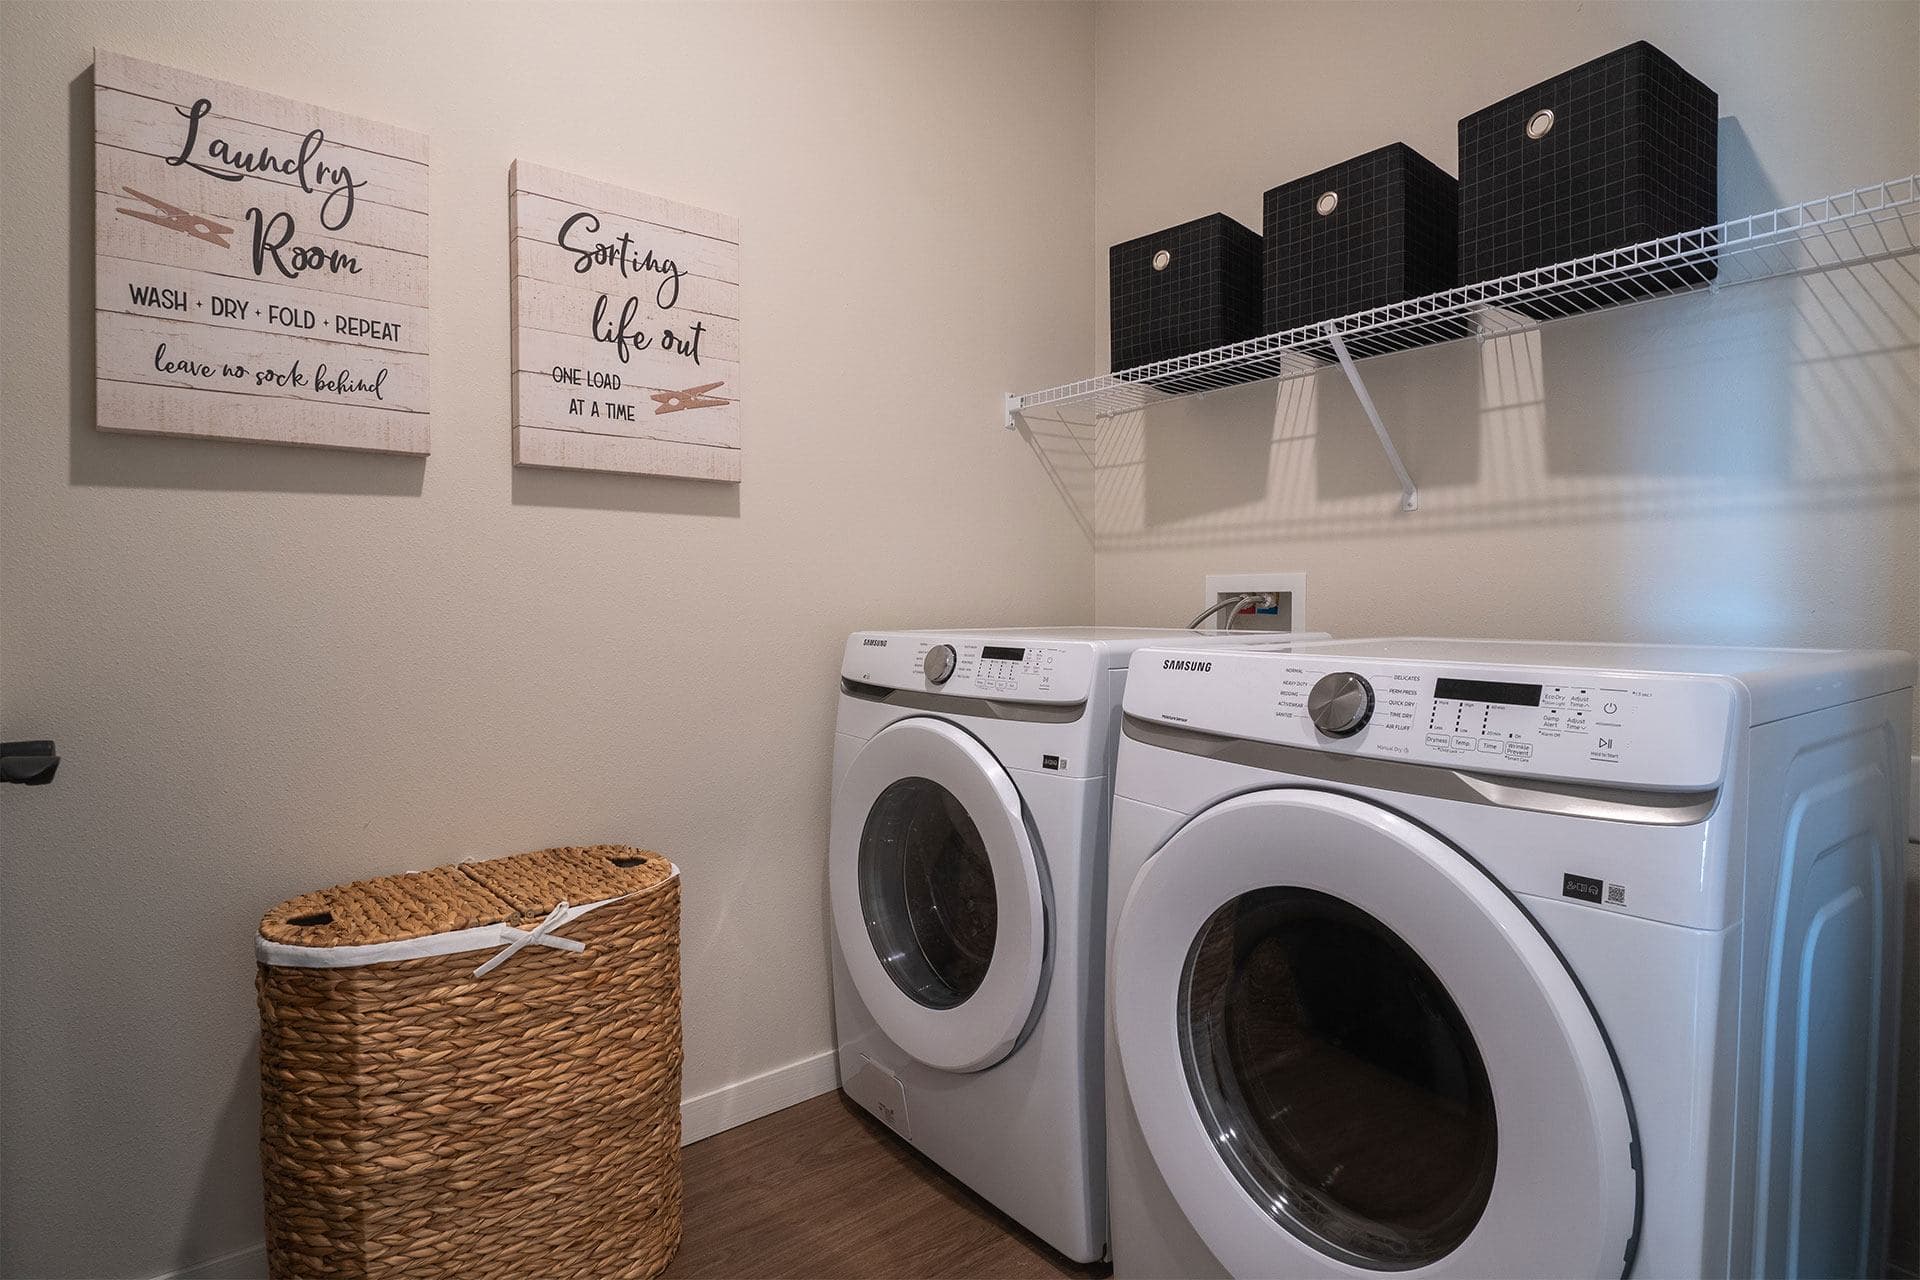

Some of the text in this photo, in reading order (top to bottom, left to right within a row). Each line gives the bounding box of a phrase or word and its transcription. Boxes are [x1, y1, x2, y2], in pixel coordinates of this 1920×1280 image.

[165, 98, 368, 231] Laundry
[245, 207, 362, 279] Room
[557, 212, 688, 310] Sorting
[129, 283, 187, 312] WASH
[211, 296, 249, 320] DRY
[268, 305, 316, 330] FOLD
[336, 315, 402, 343] REPEAT
[592, 294, 707, 366] life out
[154, 343, 389, 400] leave no sock behind
[552, 366, 621, 391] ONE LOAD
[569, 398, 636, 422] AT A TIME
[863, 639, 888, 647] SAMSUNG
[1163, 659, 1212, 673] SAMSUNG
[1388, 699, 1404, 707] QUICK
[1426, 736, 1449, 744] Dryness
